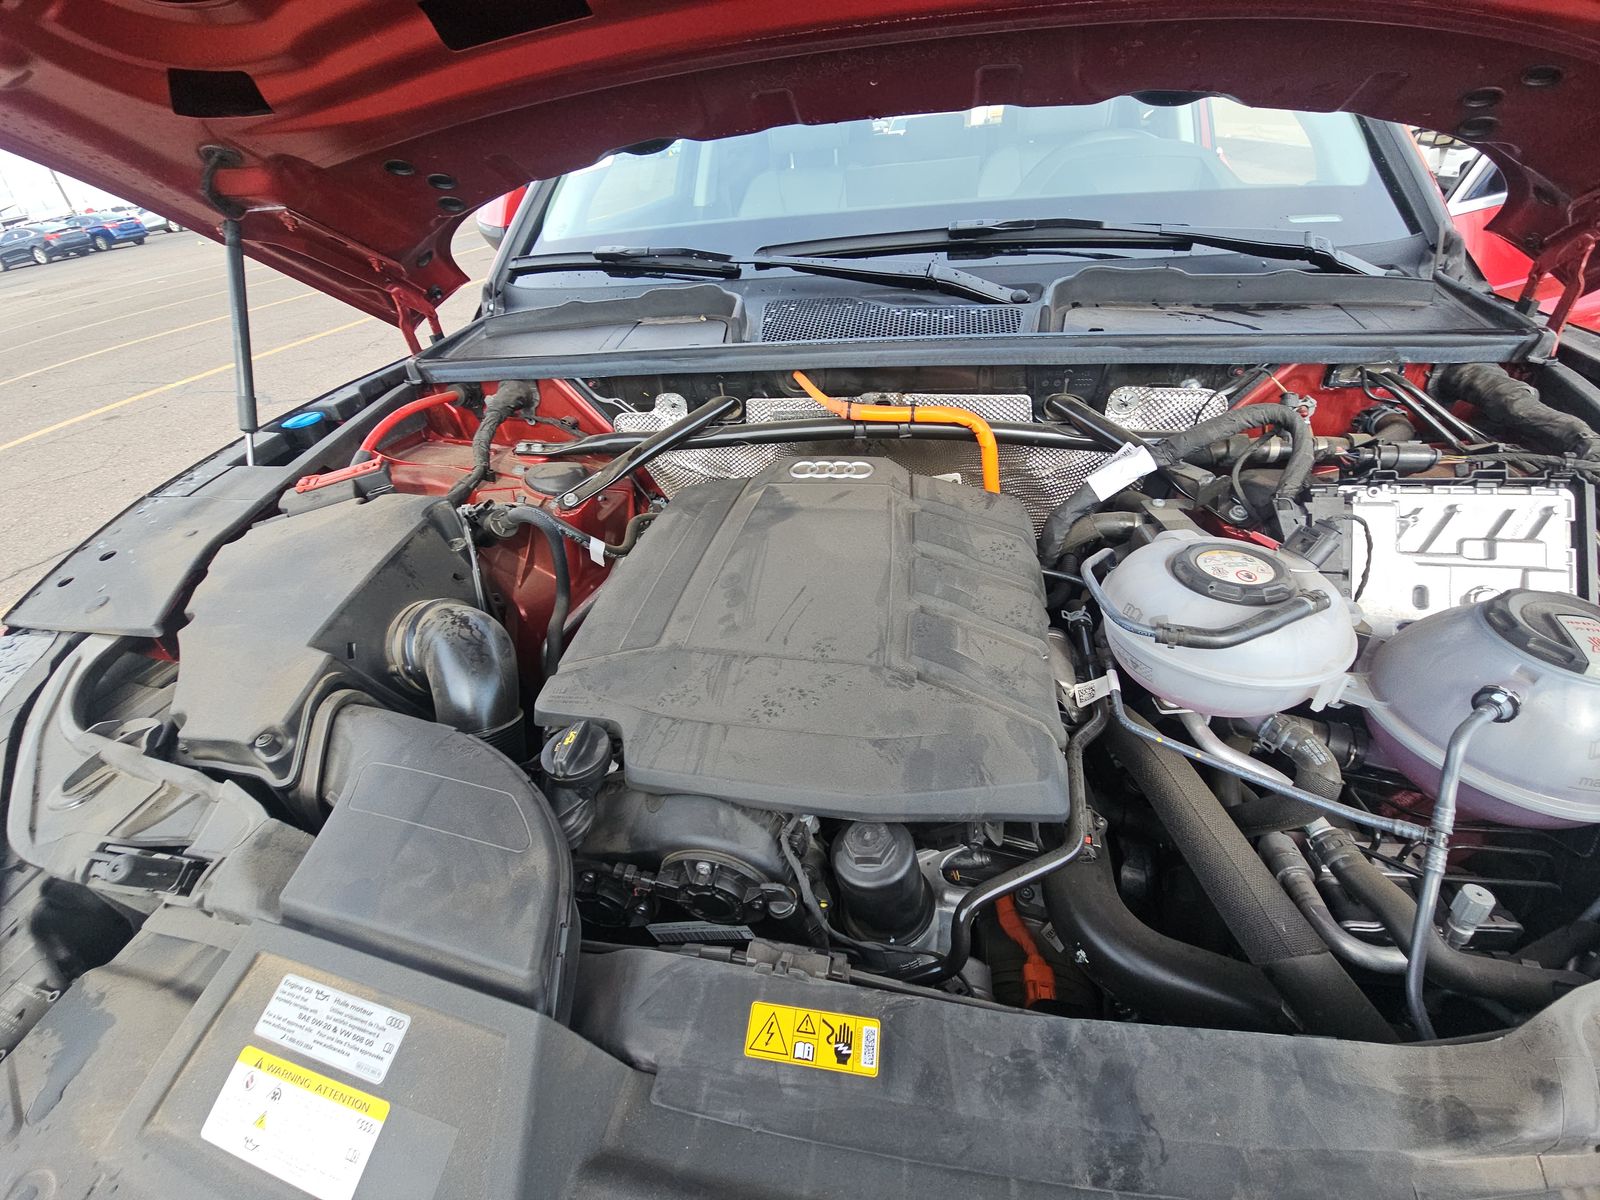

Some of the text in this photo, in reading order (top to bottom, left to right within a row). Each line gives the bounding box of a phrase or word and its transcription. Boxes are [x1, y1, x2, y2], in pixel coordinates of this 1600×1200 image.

[284, 979, 313, 994] Engine Oil
[334, 997, 374, 1016] Huile moteur
[297, 1012, 311, 1023] SAE
[311, 1018, 332, 1031] 0W-20
[340, 1029, 352, 1038] VW
[365, 1038, 374, 1047] 00
[266, 1063, 371, 1113] WARNING ATTENTION
